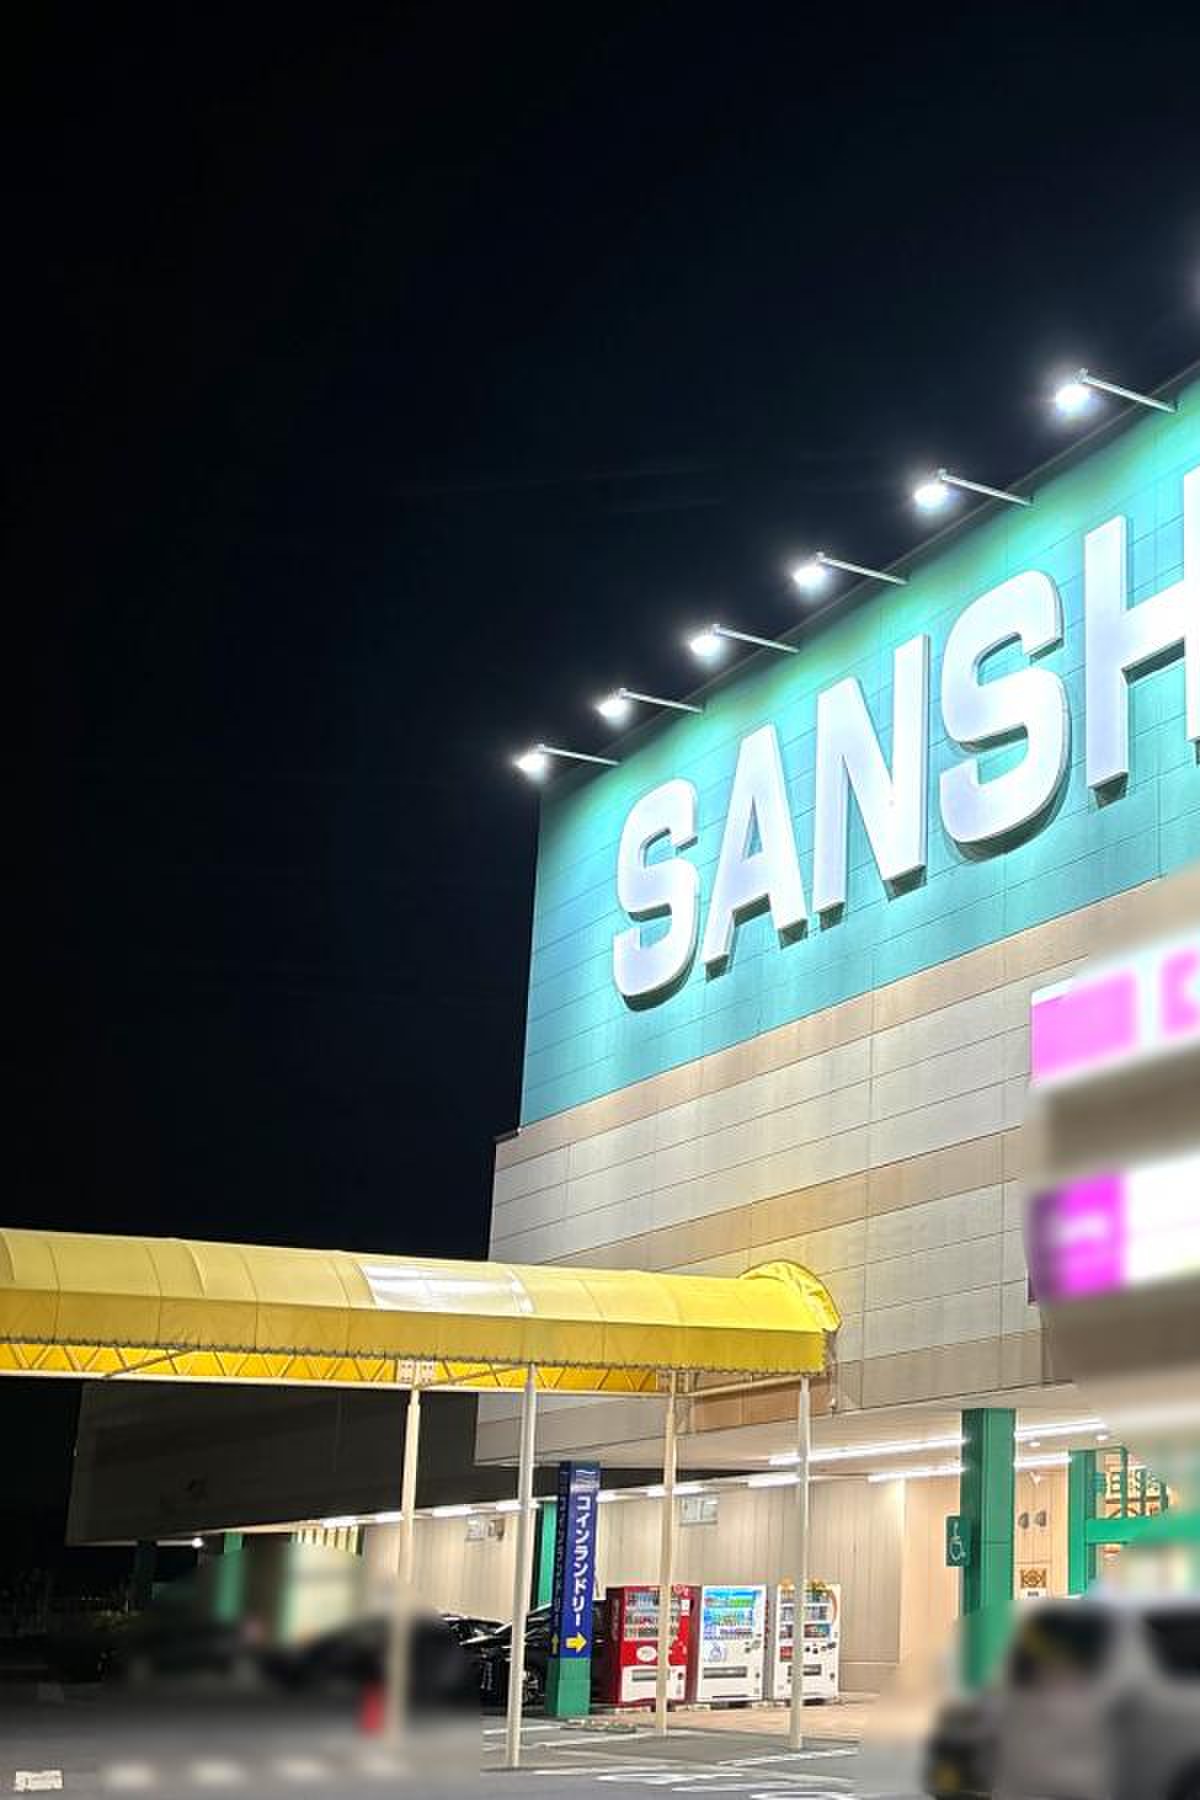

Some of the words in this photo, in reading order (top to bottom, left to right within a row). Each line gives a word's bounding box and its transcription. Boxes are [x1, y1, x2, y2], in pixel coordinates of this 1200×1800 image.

[572, 1496, 592, 1626] コインランドリー
